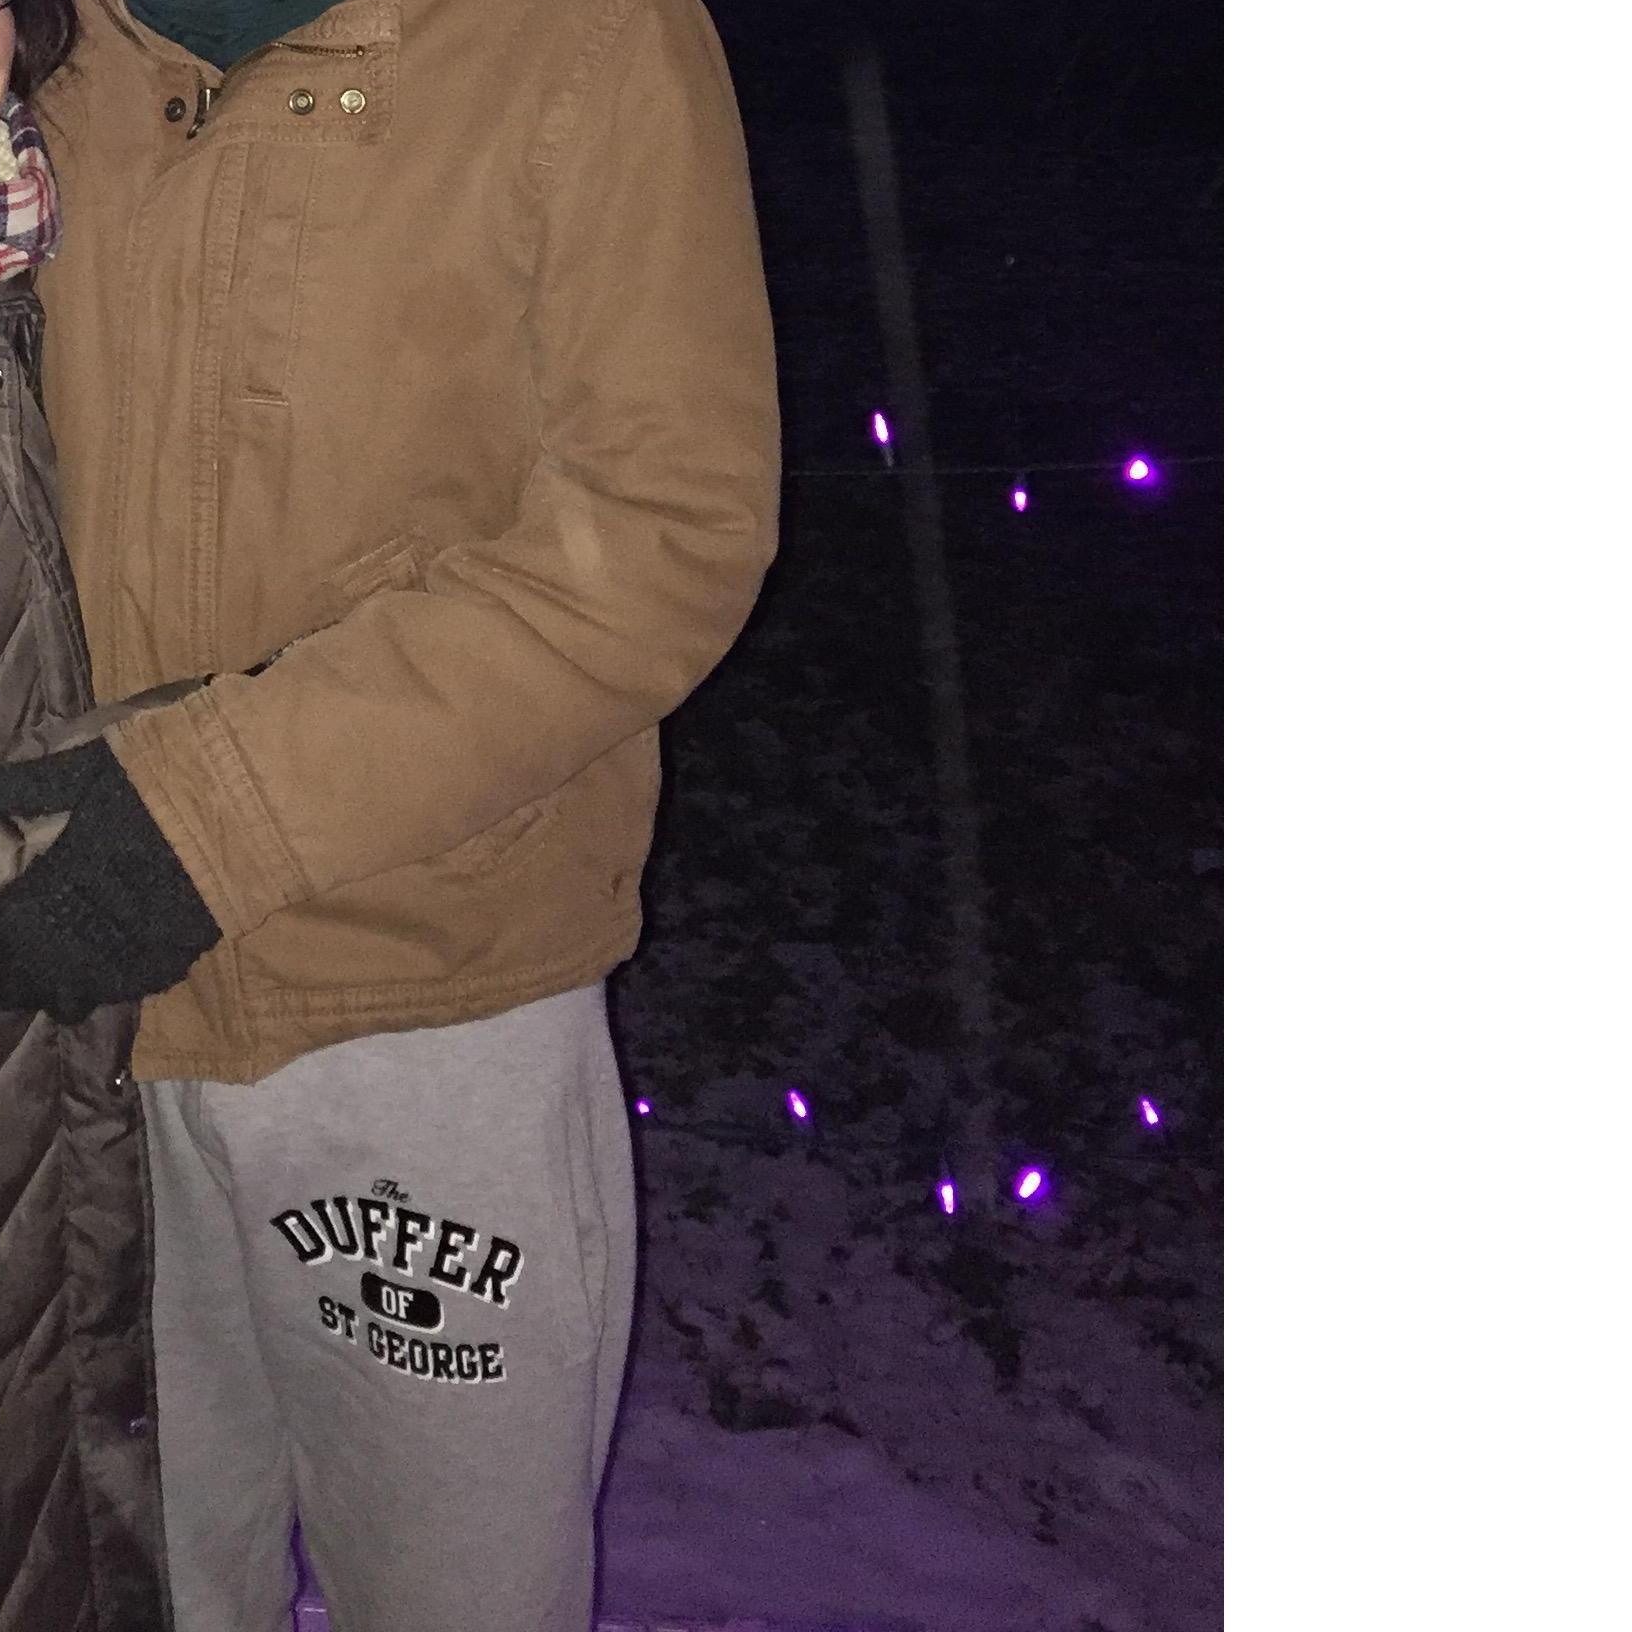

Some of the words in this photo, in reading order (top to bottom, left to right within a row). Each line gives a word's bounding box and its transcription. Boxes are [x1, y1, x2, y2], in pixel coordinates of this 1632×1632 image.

[370, 1179, 410, 1204] The
[269, 1196, 525, 1310] DUFFER
[381, 1285, 414, 1319] OF
[318, 1295, 359, 1345] ST
[368, 1321, 507, 1384] GEORGE
